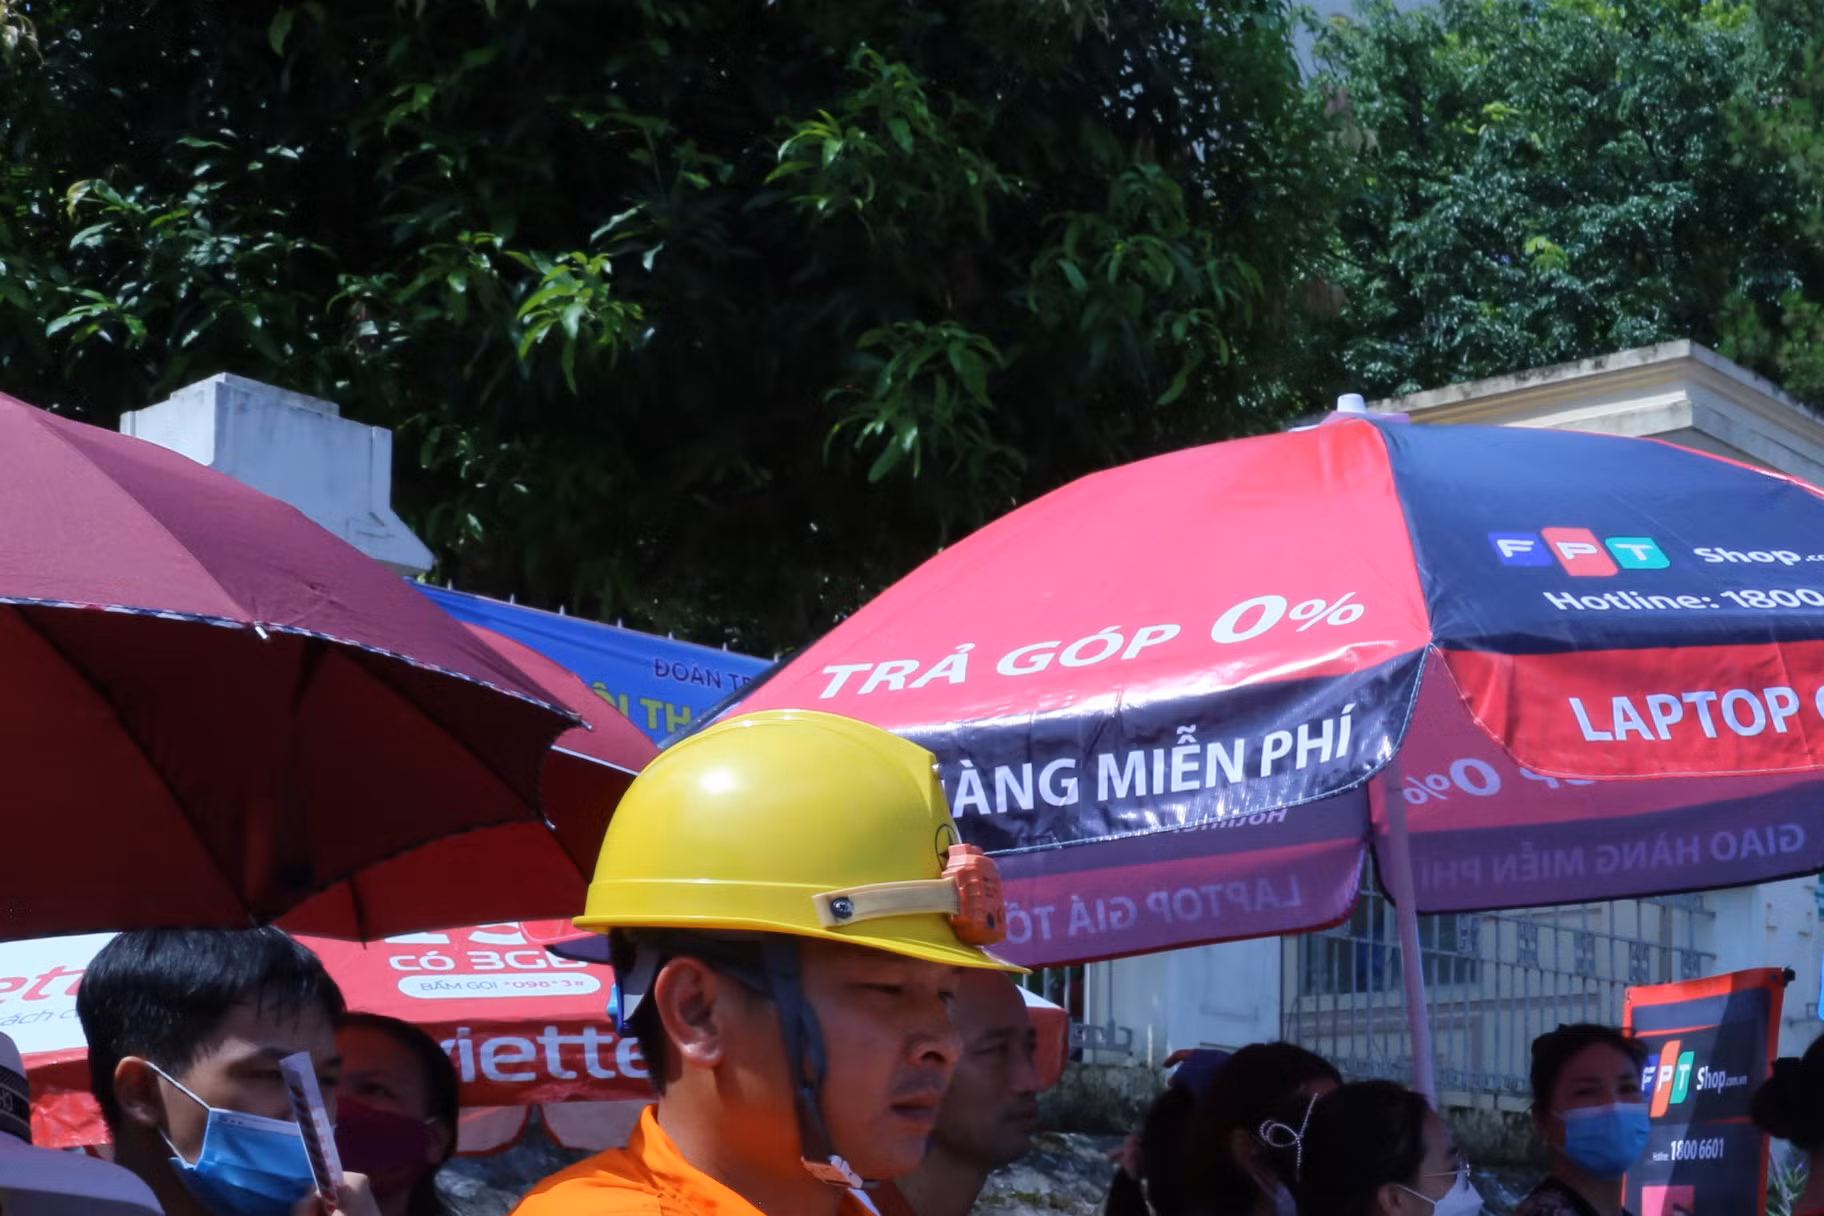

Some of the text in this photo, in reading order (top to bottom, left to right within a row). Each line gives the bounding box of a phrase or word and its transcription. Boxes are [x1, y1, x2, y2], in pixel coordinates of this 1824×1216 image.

[1493, 534, 1660, 567] FPT
[1543, 590, 1720, 611] Hotline:
[819, 592, 1366, 699] TRẢ GÓP 0%
[1568, 687, 1799, 742] LAPTOP
[945, 702, 1357, 818] ÀNG MIỄN PHÍ
[440, 1026, 652, 1082] iette
[1671, 1139, 1697, 1160] 1800
[1699, 1138, 1724, 1159] 6601
